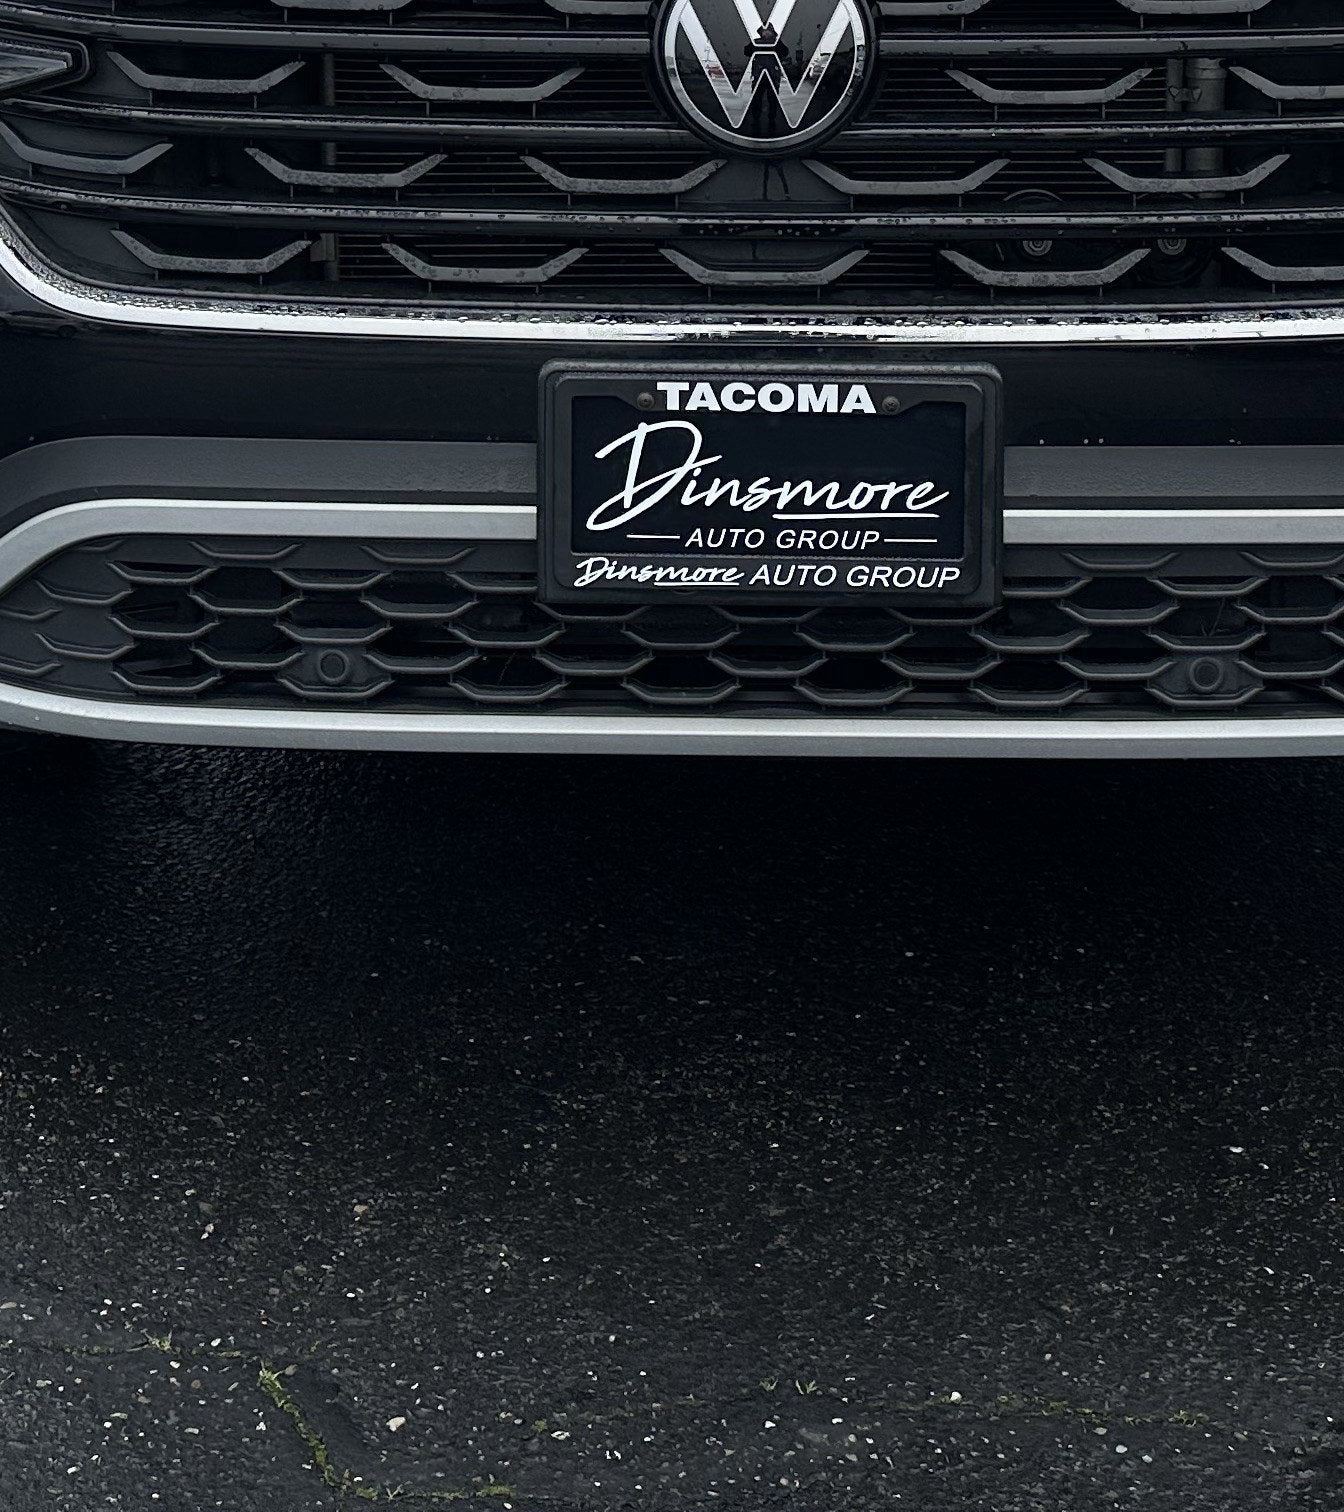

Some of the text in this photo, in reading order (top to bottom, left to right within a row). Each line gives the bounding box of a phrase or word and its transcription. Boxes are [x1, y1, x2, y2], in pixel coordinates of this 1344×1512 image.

[656, 381, 877, 414] TACOMA
[585, 420, 950, 532] Dinsmore
[684, 528, 880, 550] AUTO GROUP
[573, 556, 961, 589] Dinsmore AUTO GROUP
